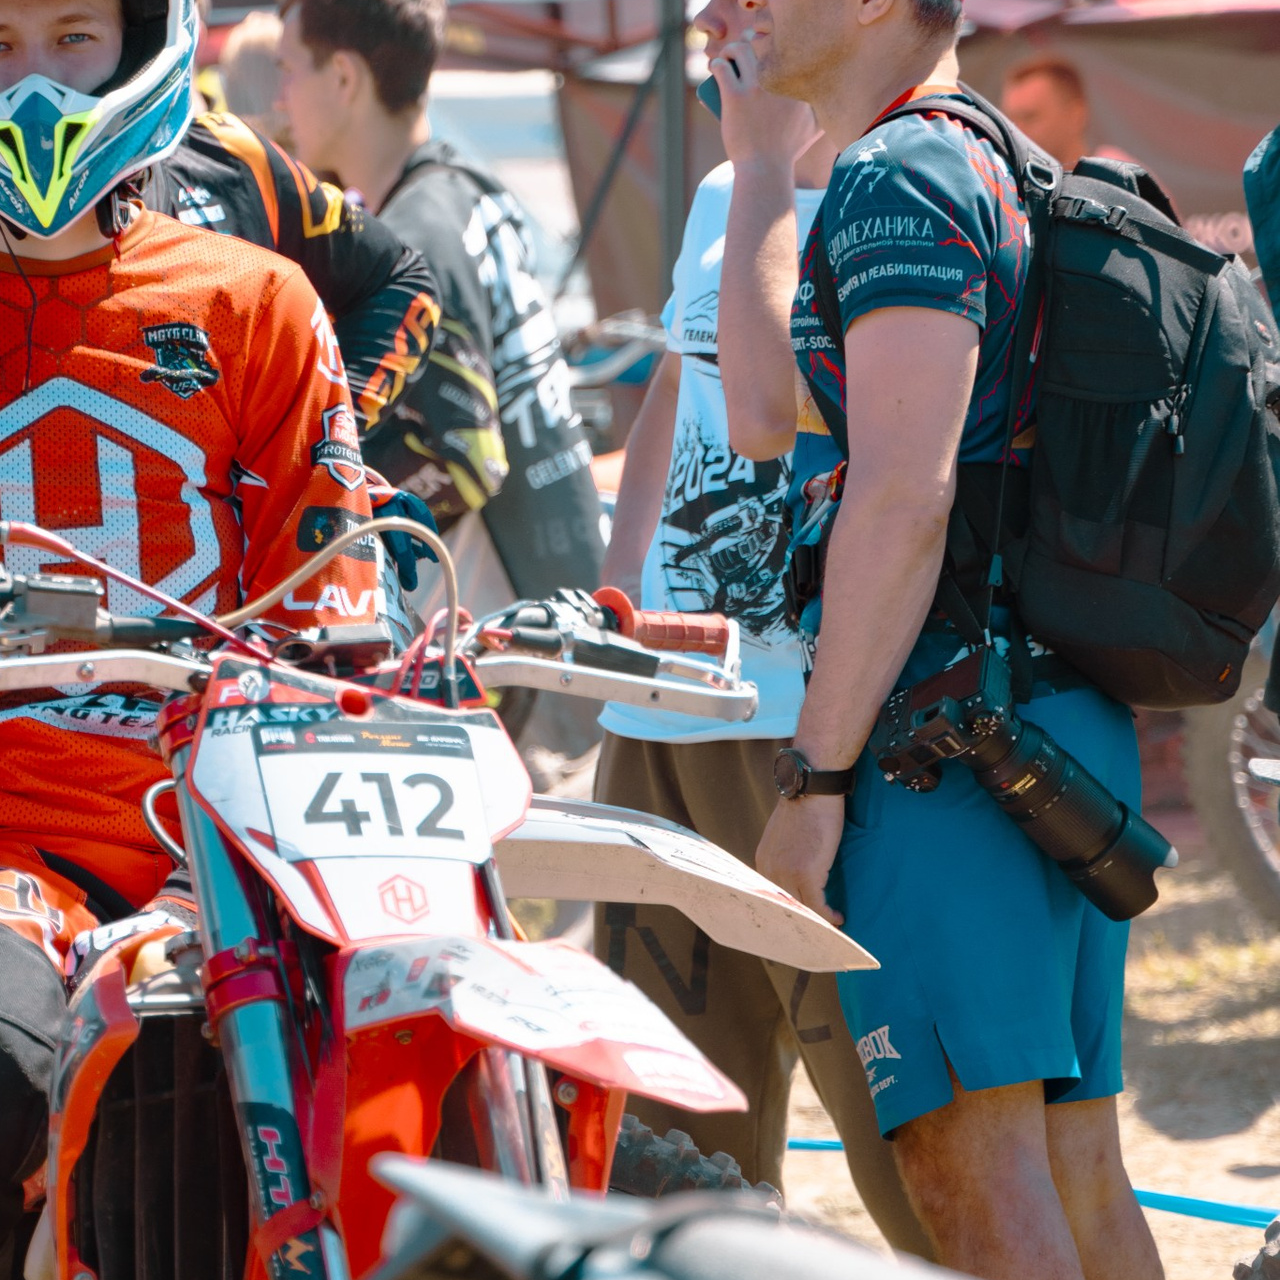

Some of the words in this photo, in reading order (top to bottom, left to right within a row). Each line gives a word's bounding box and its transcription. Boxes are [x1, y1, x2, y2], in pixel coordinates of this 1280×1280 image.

[828, 215, 934, 266] БИОМЕХАНИКА
[895, 238, 935, 248] терапии
[868, 262, 964, 282] РЕАБИЛИТАЦИЯ
[671, 444, 756, 514] 2024
[212, 707, 339, 730] HASKY
[303, 771, 466, 841] 412
